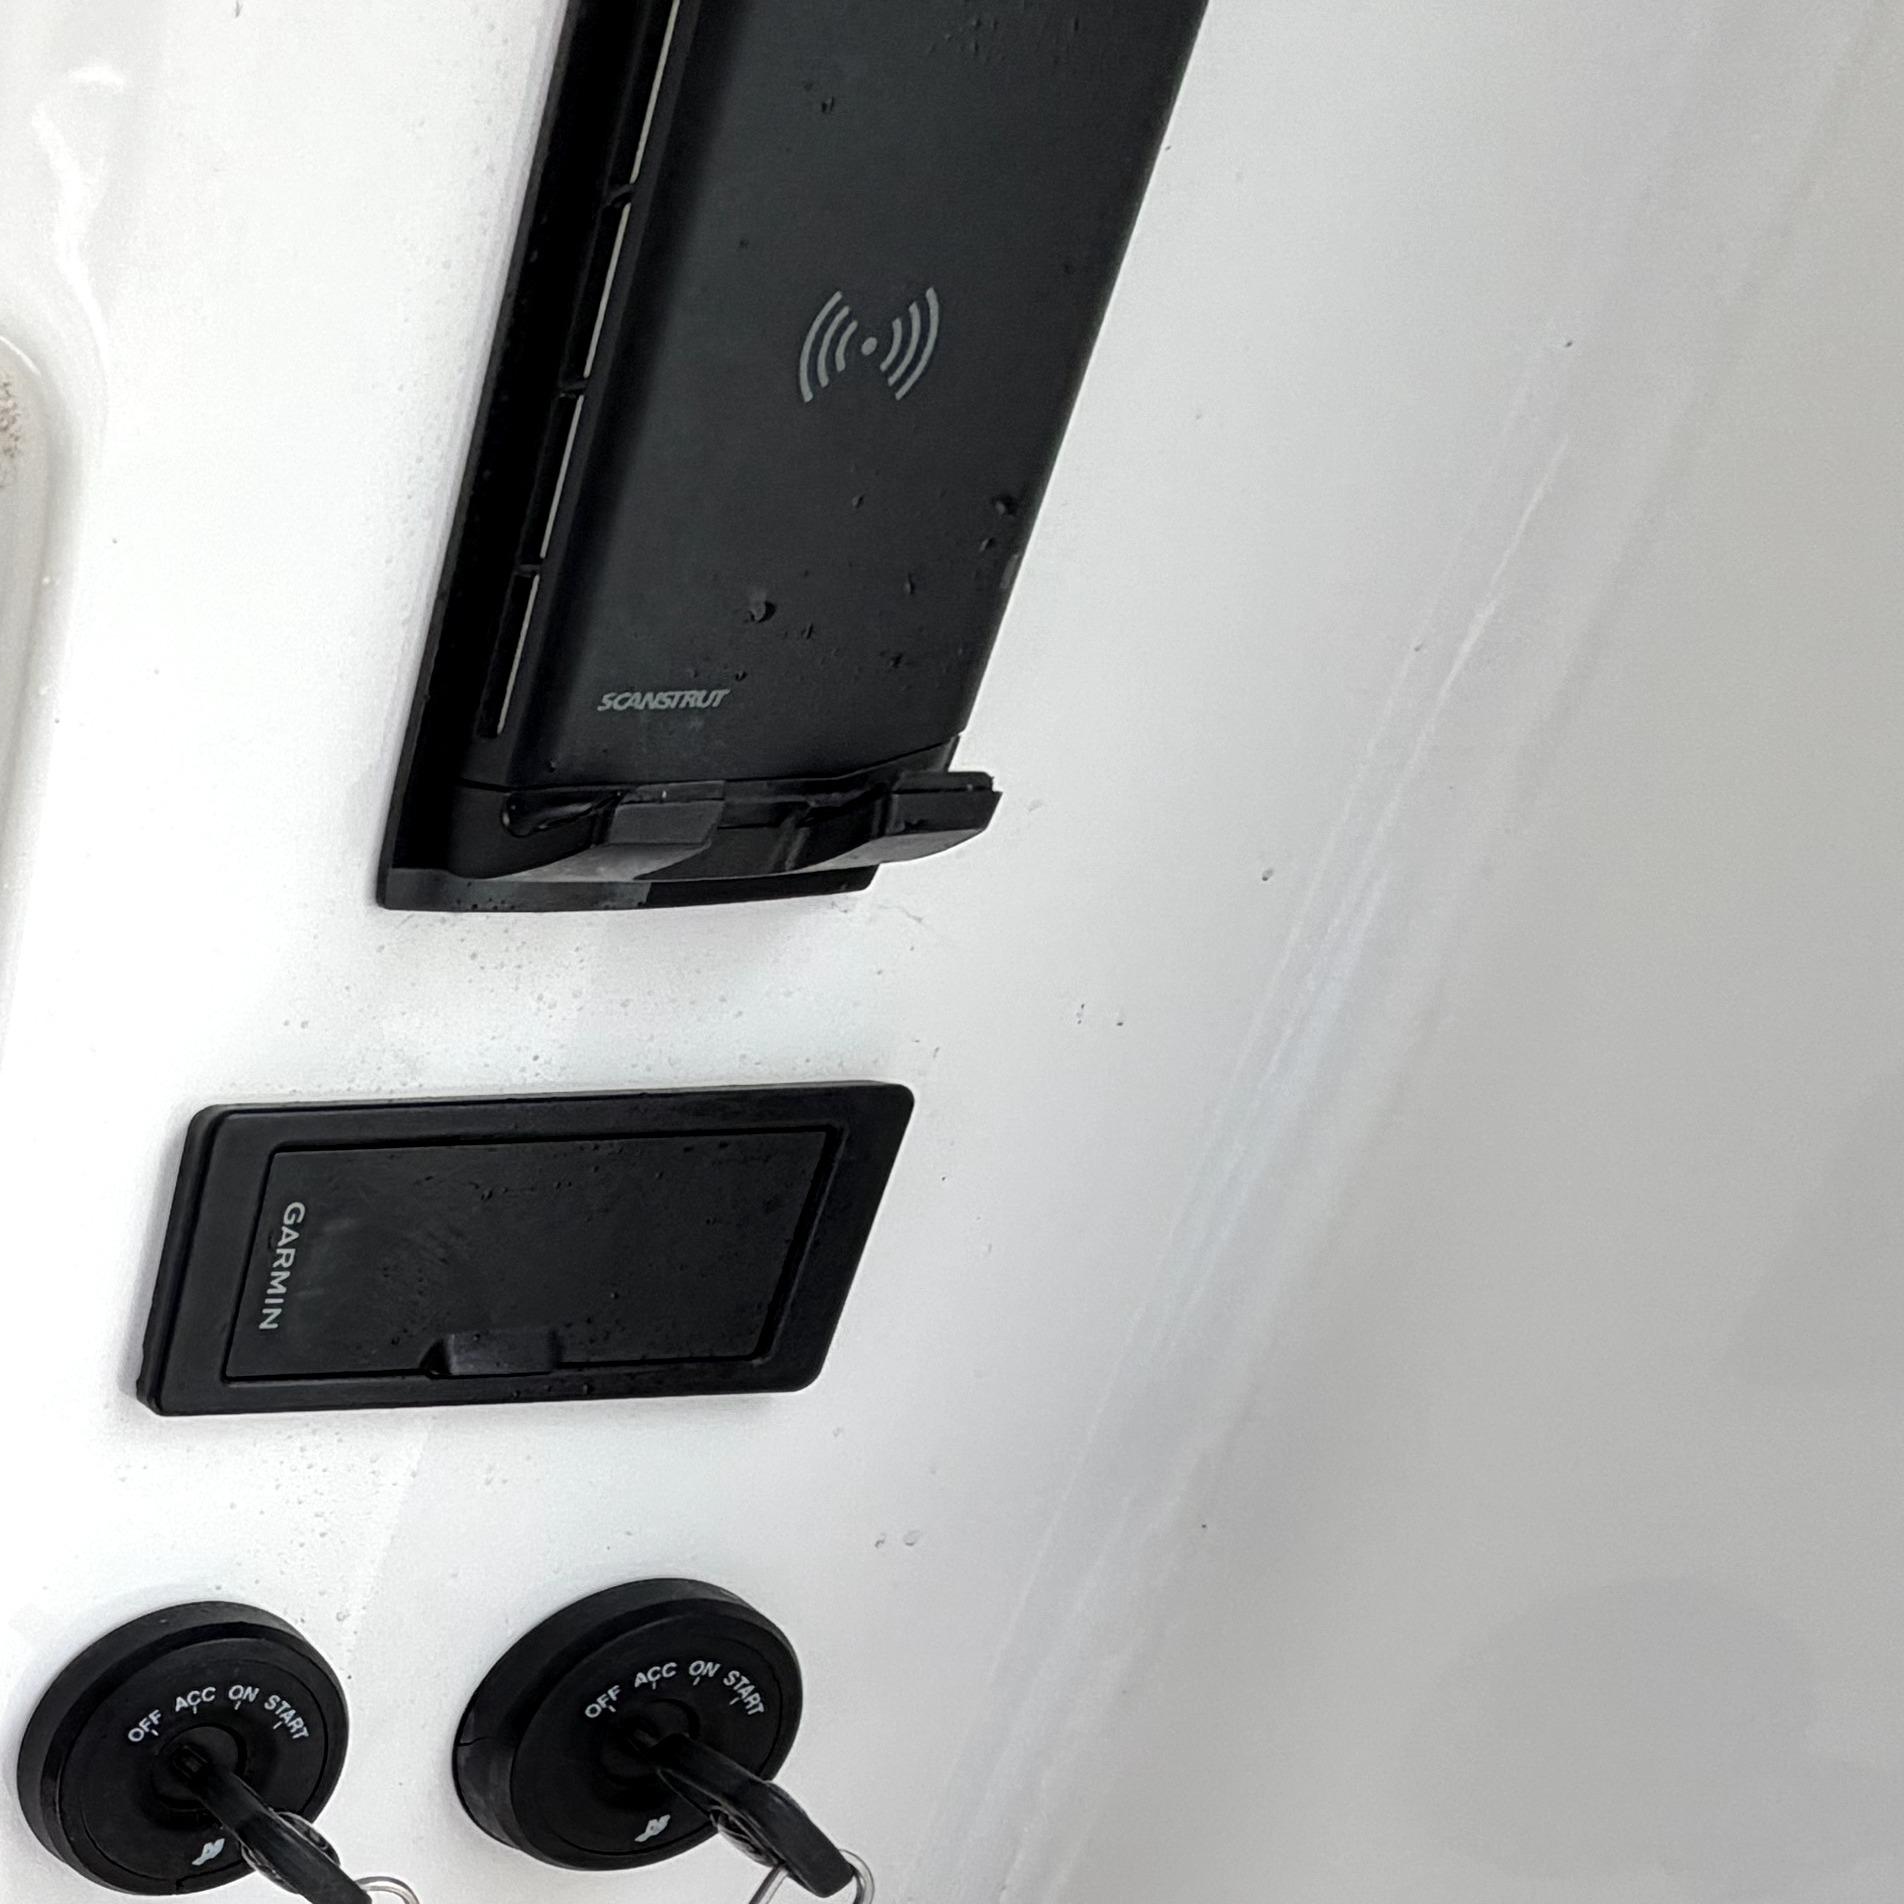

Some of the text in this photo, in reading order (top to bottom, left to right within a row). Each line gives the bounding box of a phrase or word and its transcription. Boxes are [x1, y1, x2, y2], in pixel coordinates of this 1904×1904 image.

[598, 688, 731, 713] SCANSTRUT
[258, 1201, 306, 1331] GARMIN
[127, 1684, 310, 1743] OFF ACC ON START
[584, 1660, 765, 1719] OFF ACC ON START
